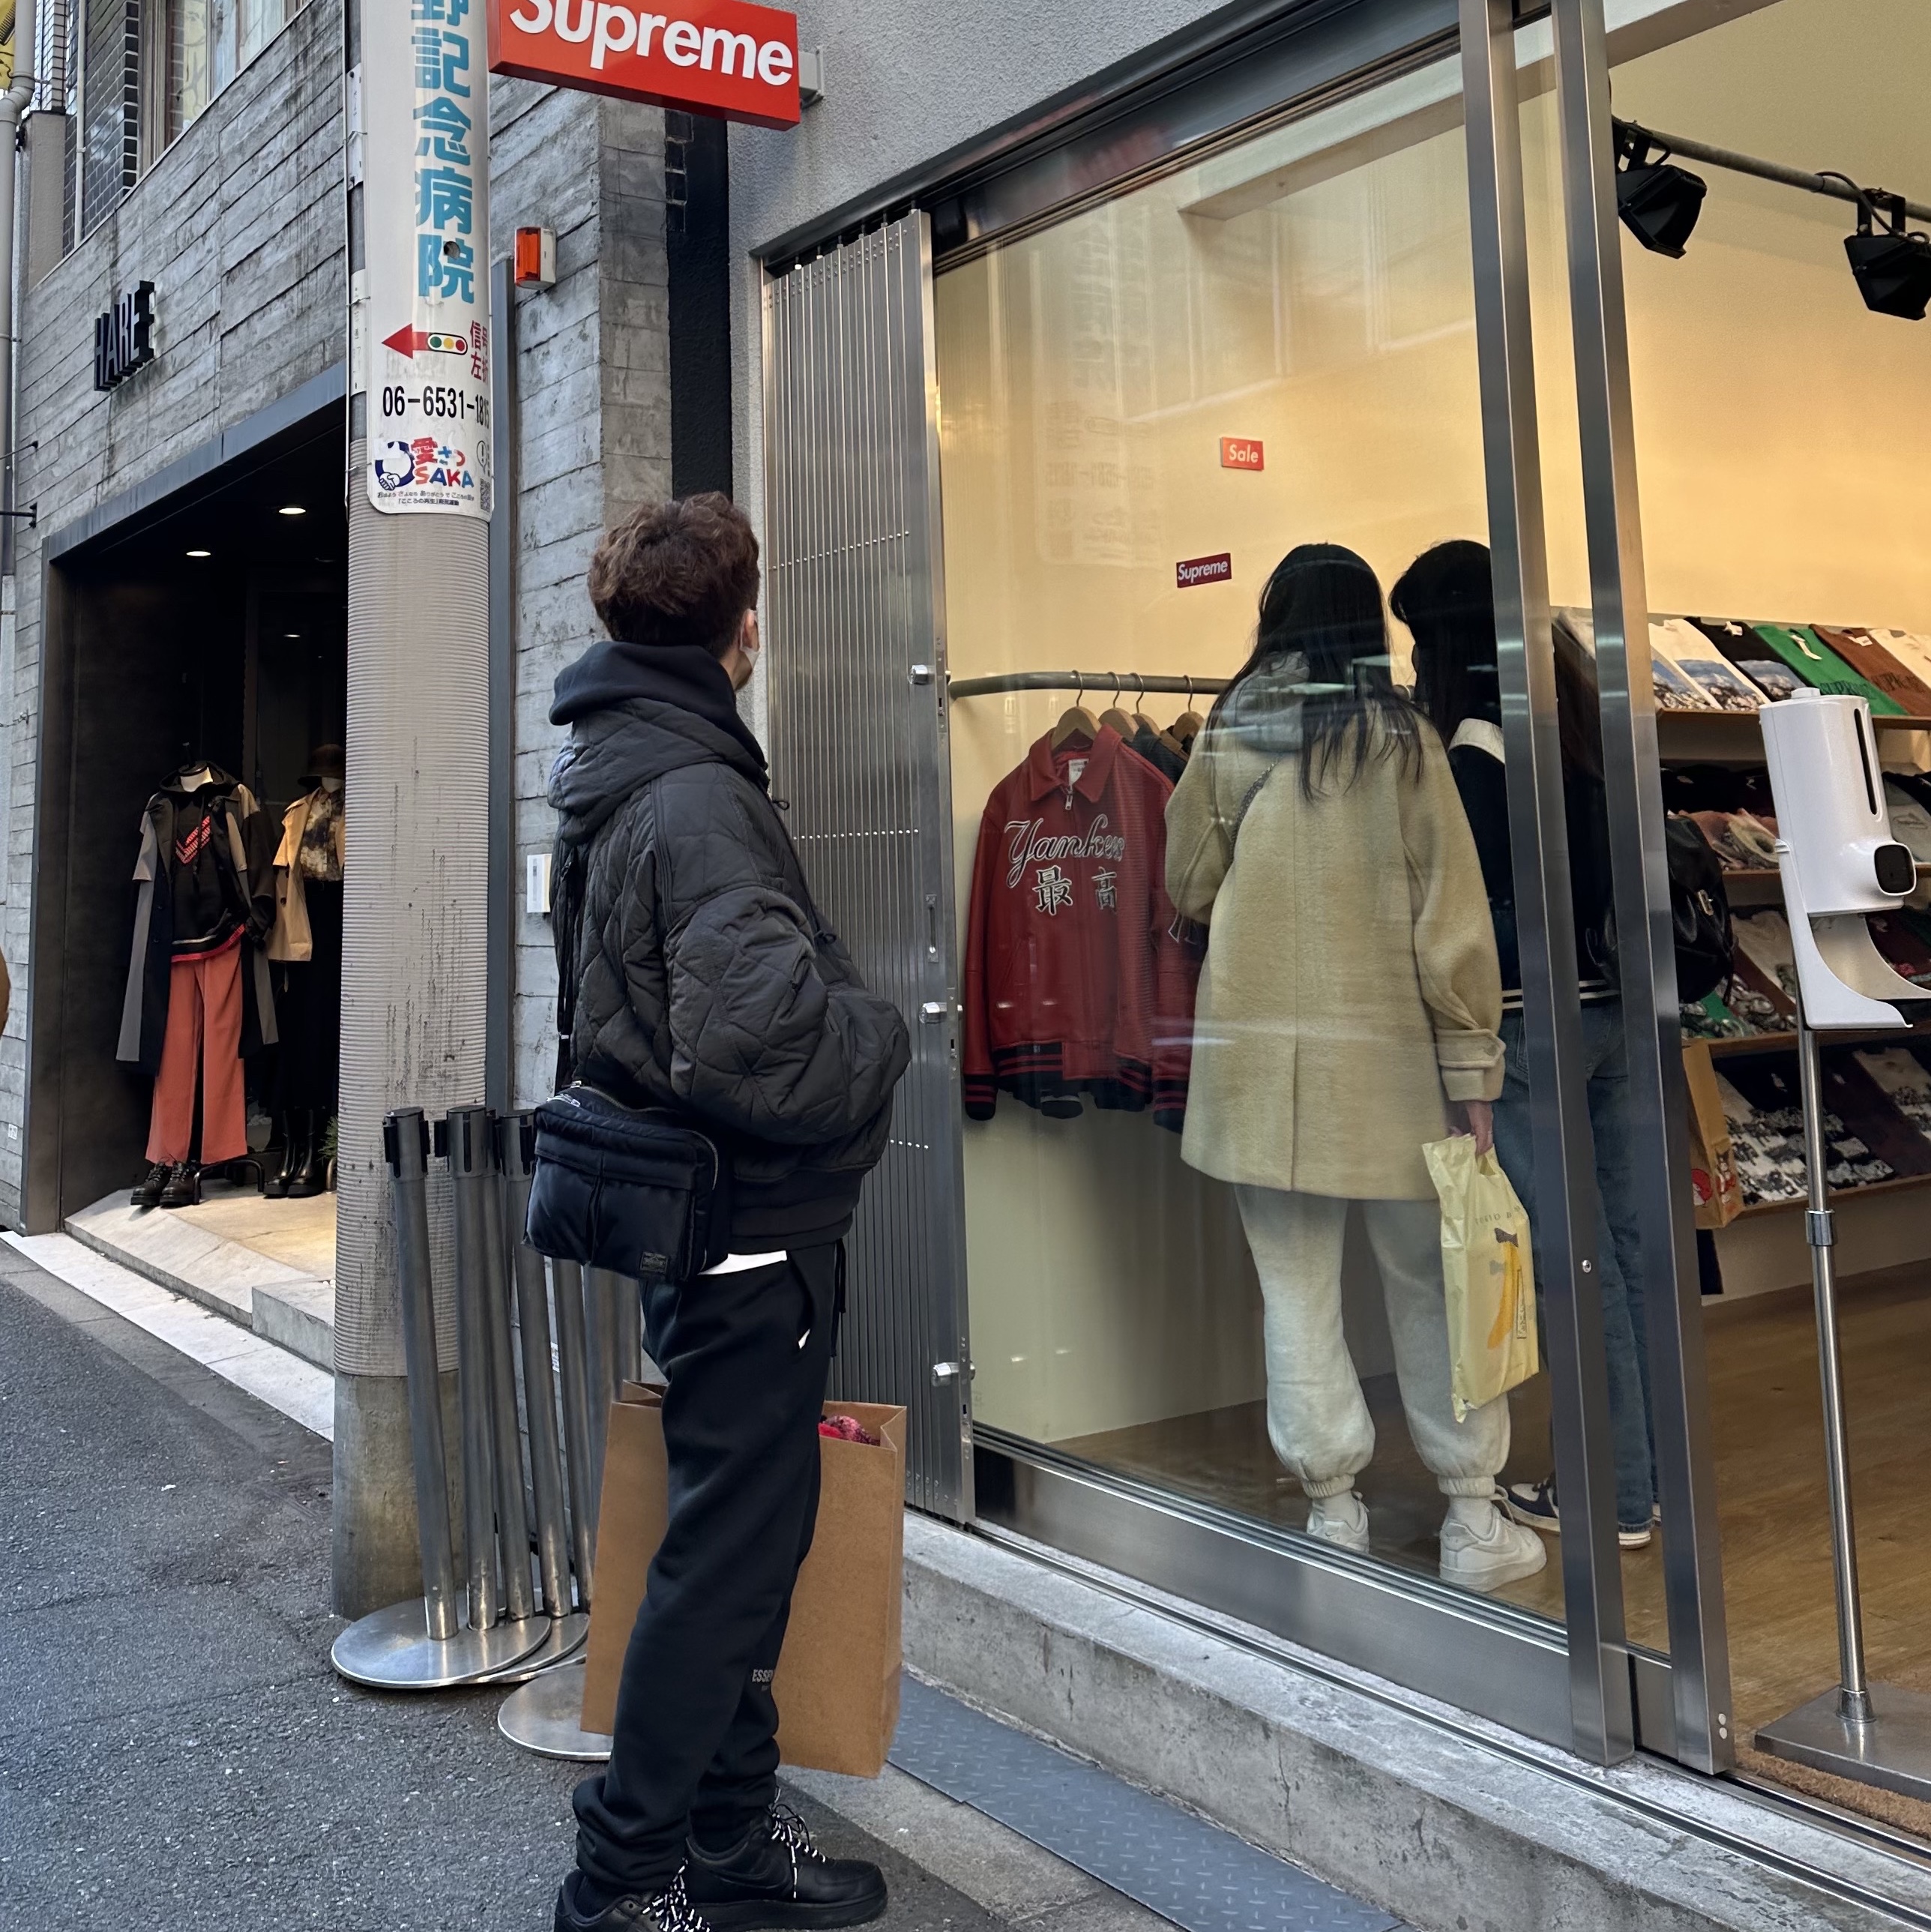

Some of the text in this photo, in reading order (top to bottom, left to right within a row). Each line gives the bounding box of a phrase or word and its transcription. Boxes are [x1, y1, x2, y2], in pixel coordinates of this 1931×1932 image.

[94, 280, 155, 392] HARE
[1229, 444, 1259, 463] Sale
[1178, 560, 1228, 583] Supreme
